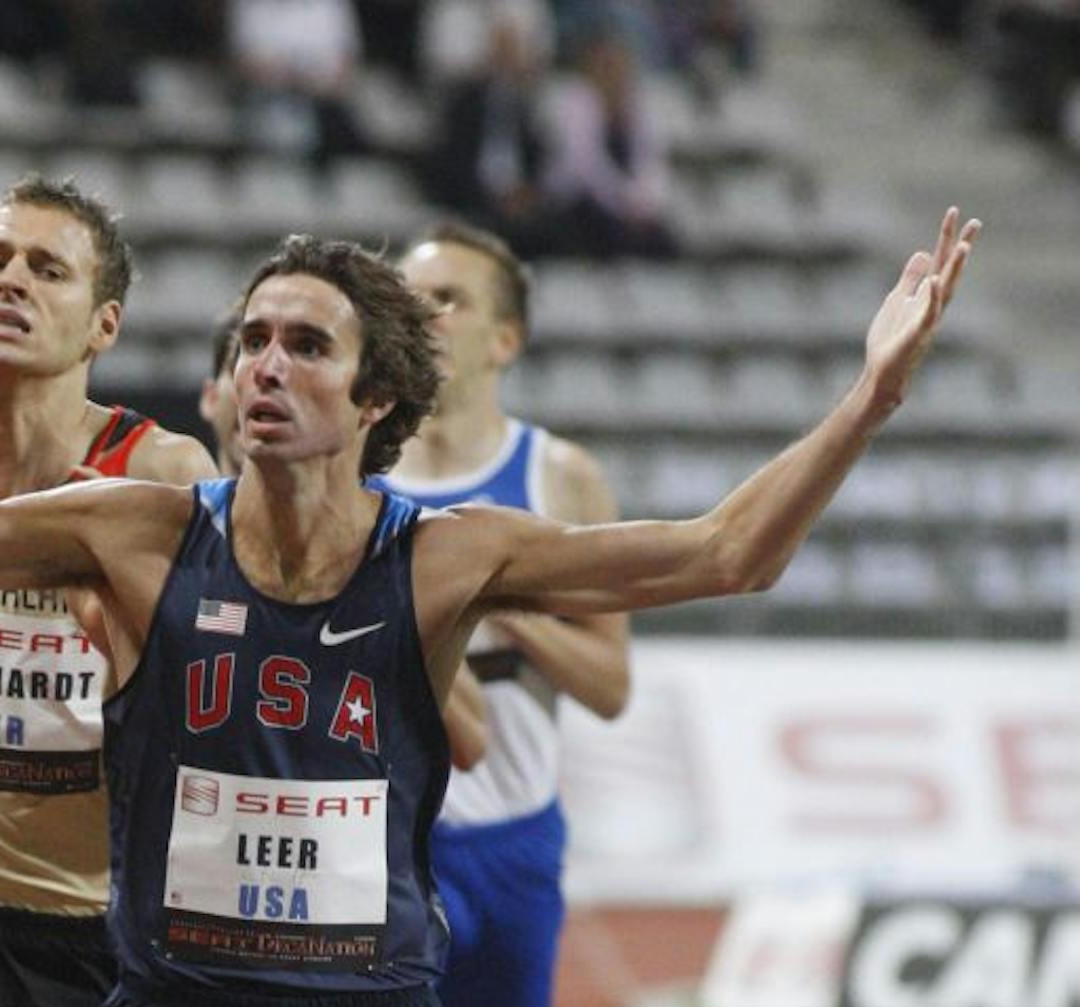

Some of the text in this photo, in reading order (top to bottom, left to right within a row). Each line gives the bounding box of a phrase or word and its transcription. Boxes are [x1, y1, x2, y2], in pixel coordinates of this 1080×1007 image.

[185, 652, 380, 754] USA
[235, 792, 381, 817] SEAT
[236, 834, 320, 870] LEER
[237, 884, 310, 921] USA
